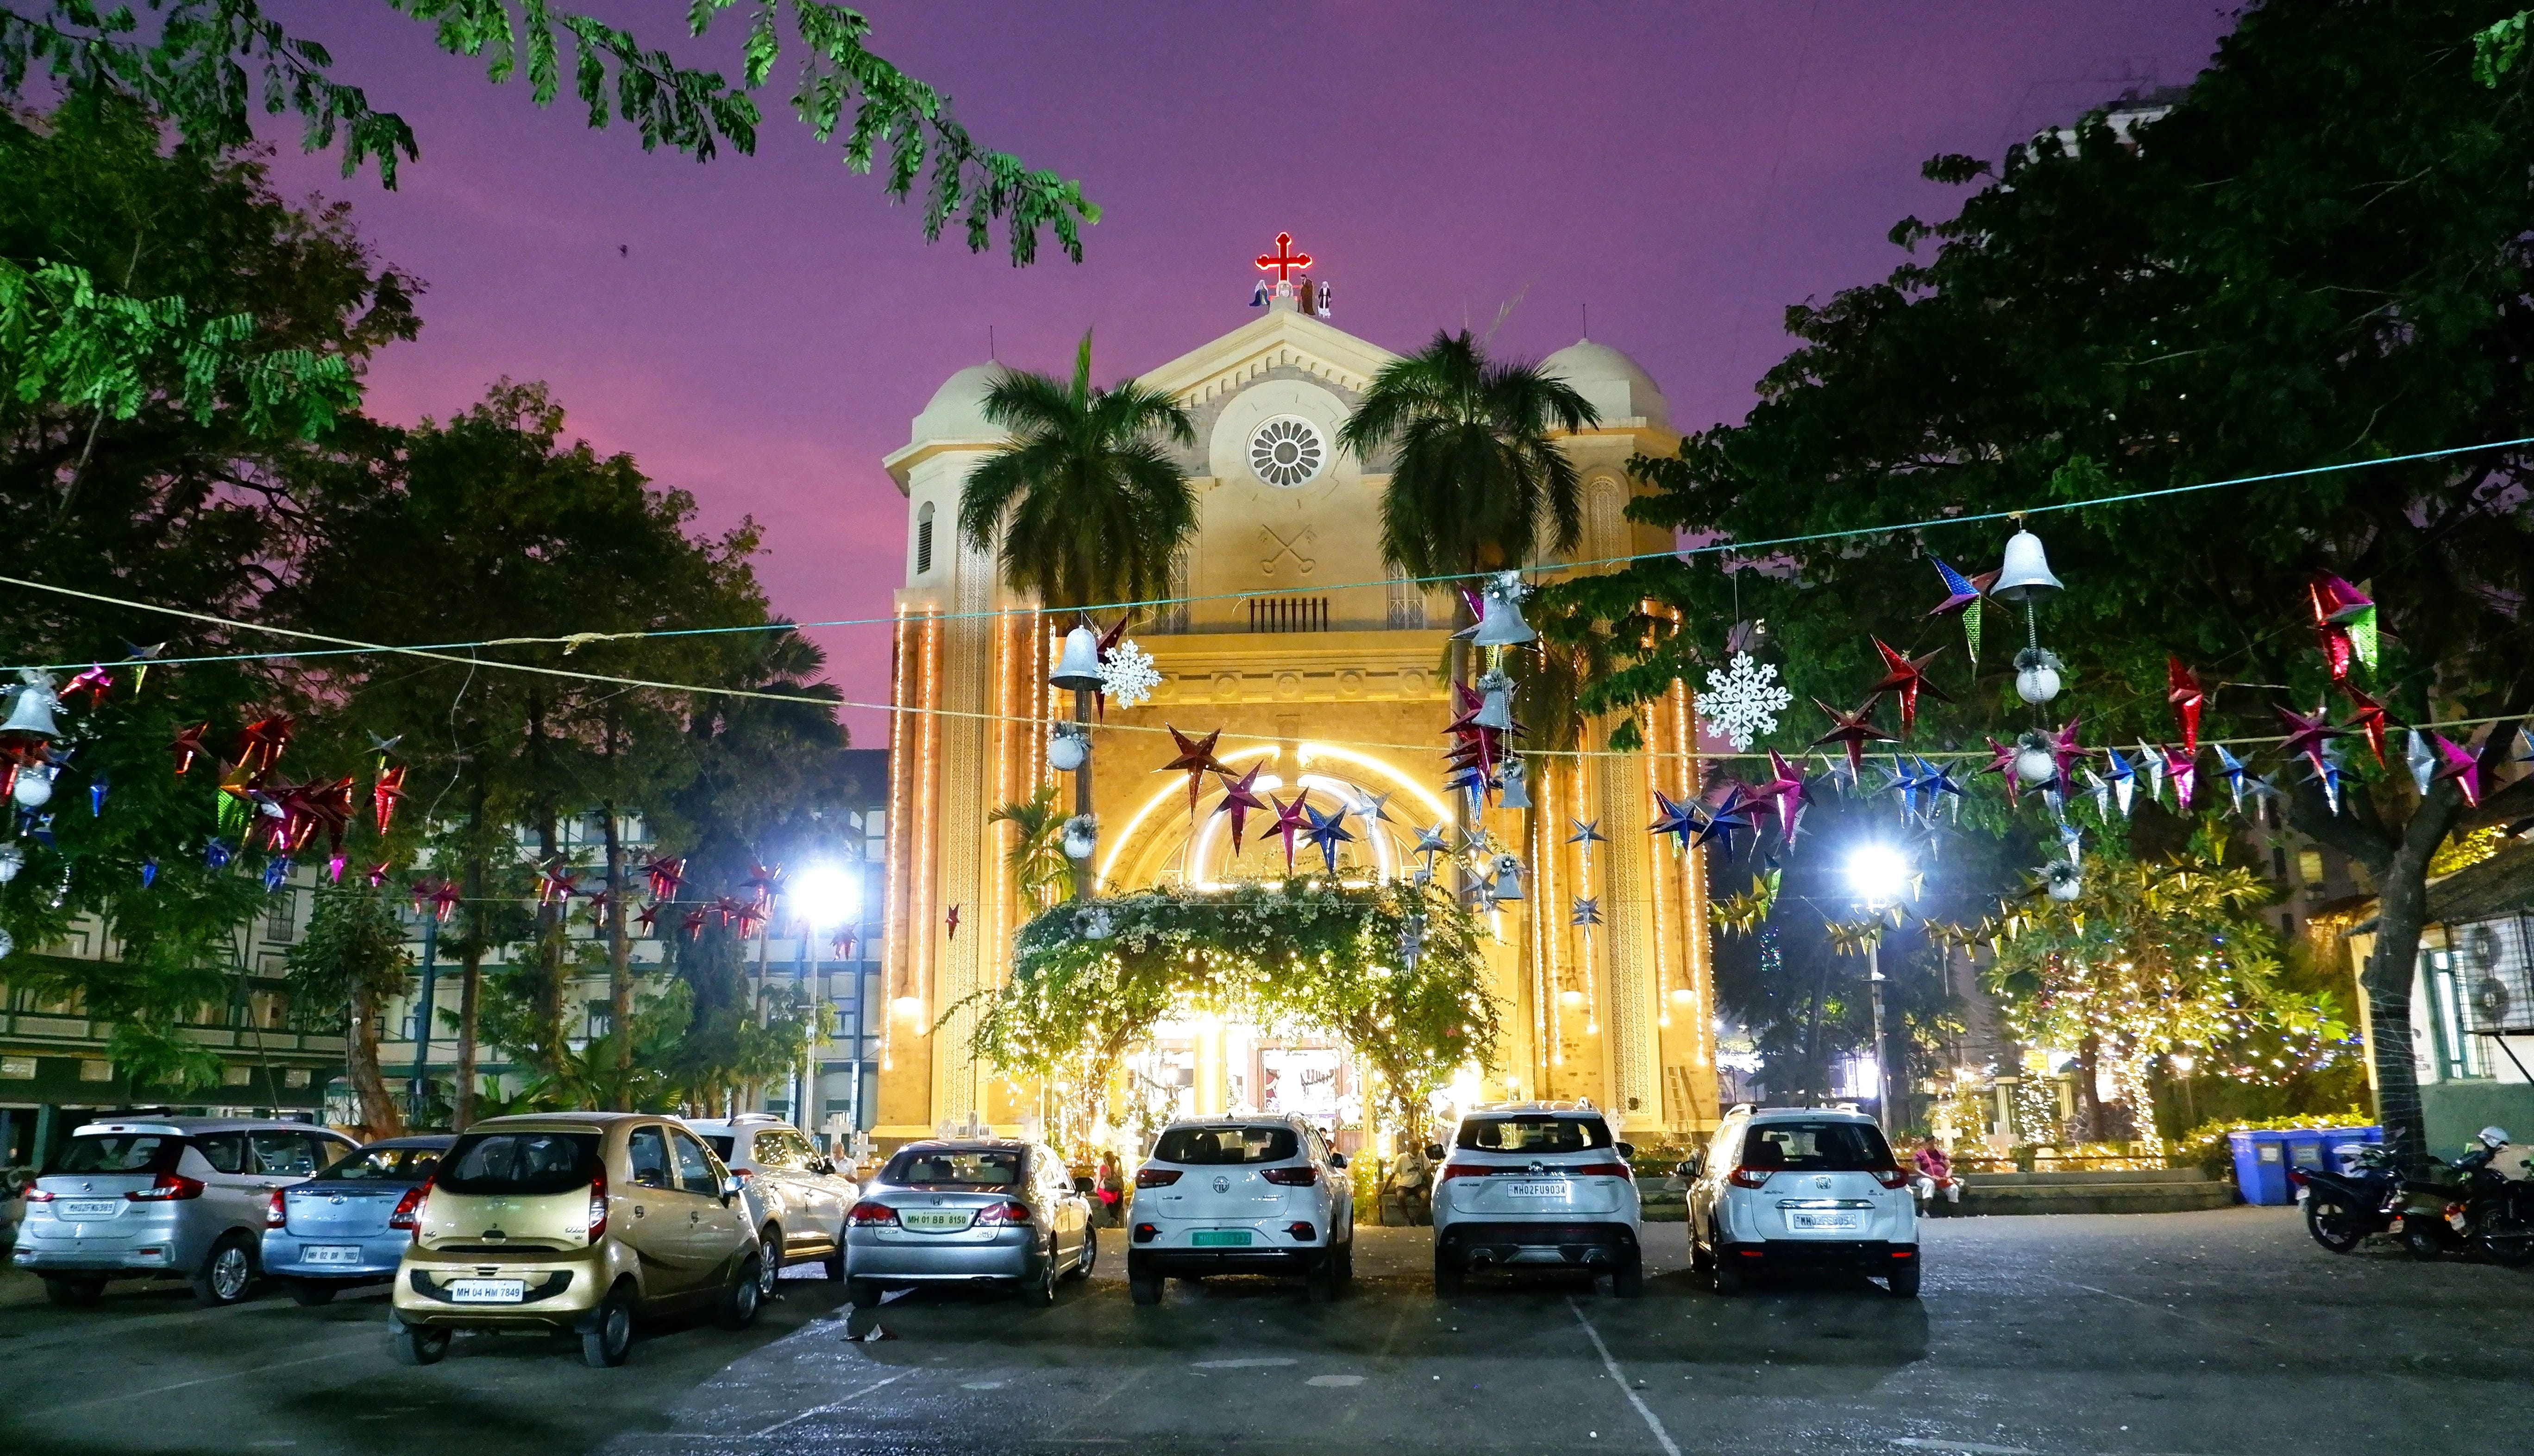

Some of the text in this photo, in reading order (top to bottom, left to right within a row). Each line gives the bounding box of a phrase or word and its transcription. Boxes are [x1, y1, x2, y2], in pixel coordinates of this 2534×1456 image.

[1513, 1185, 1565, 1194] MH02FU9034
[457, 1287, 520, 1297] MH 04 HM 7849
